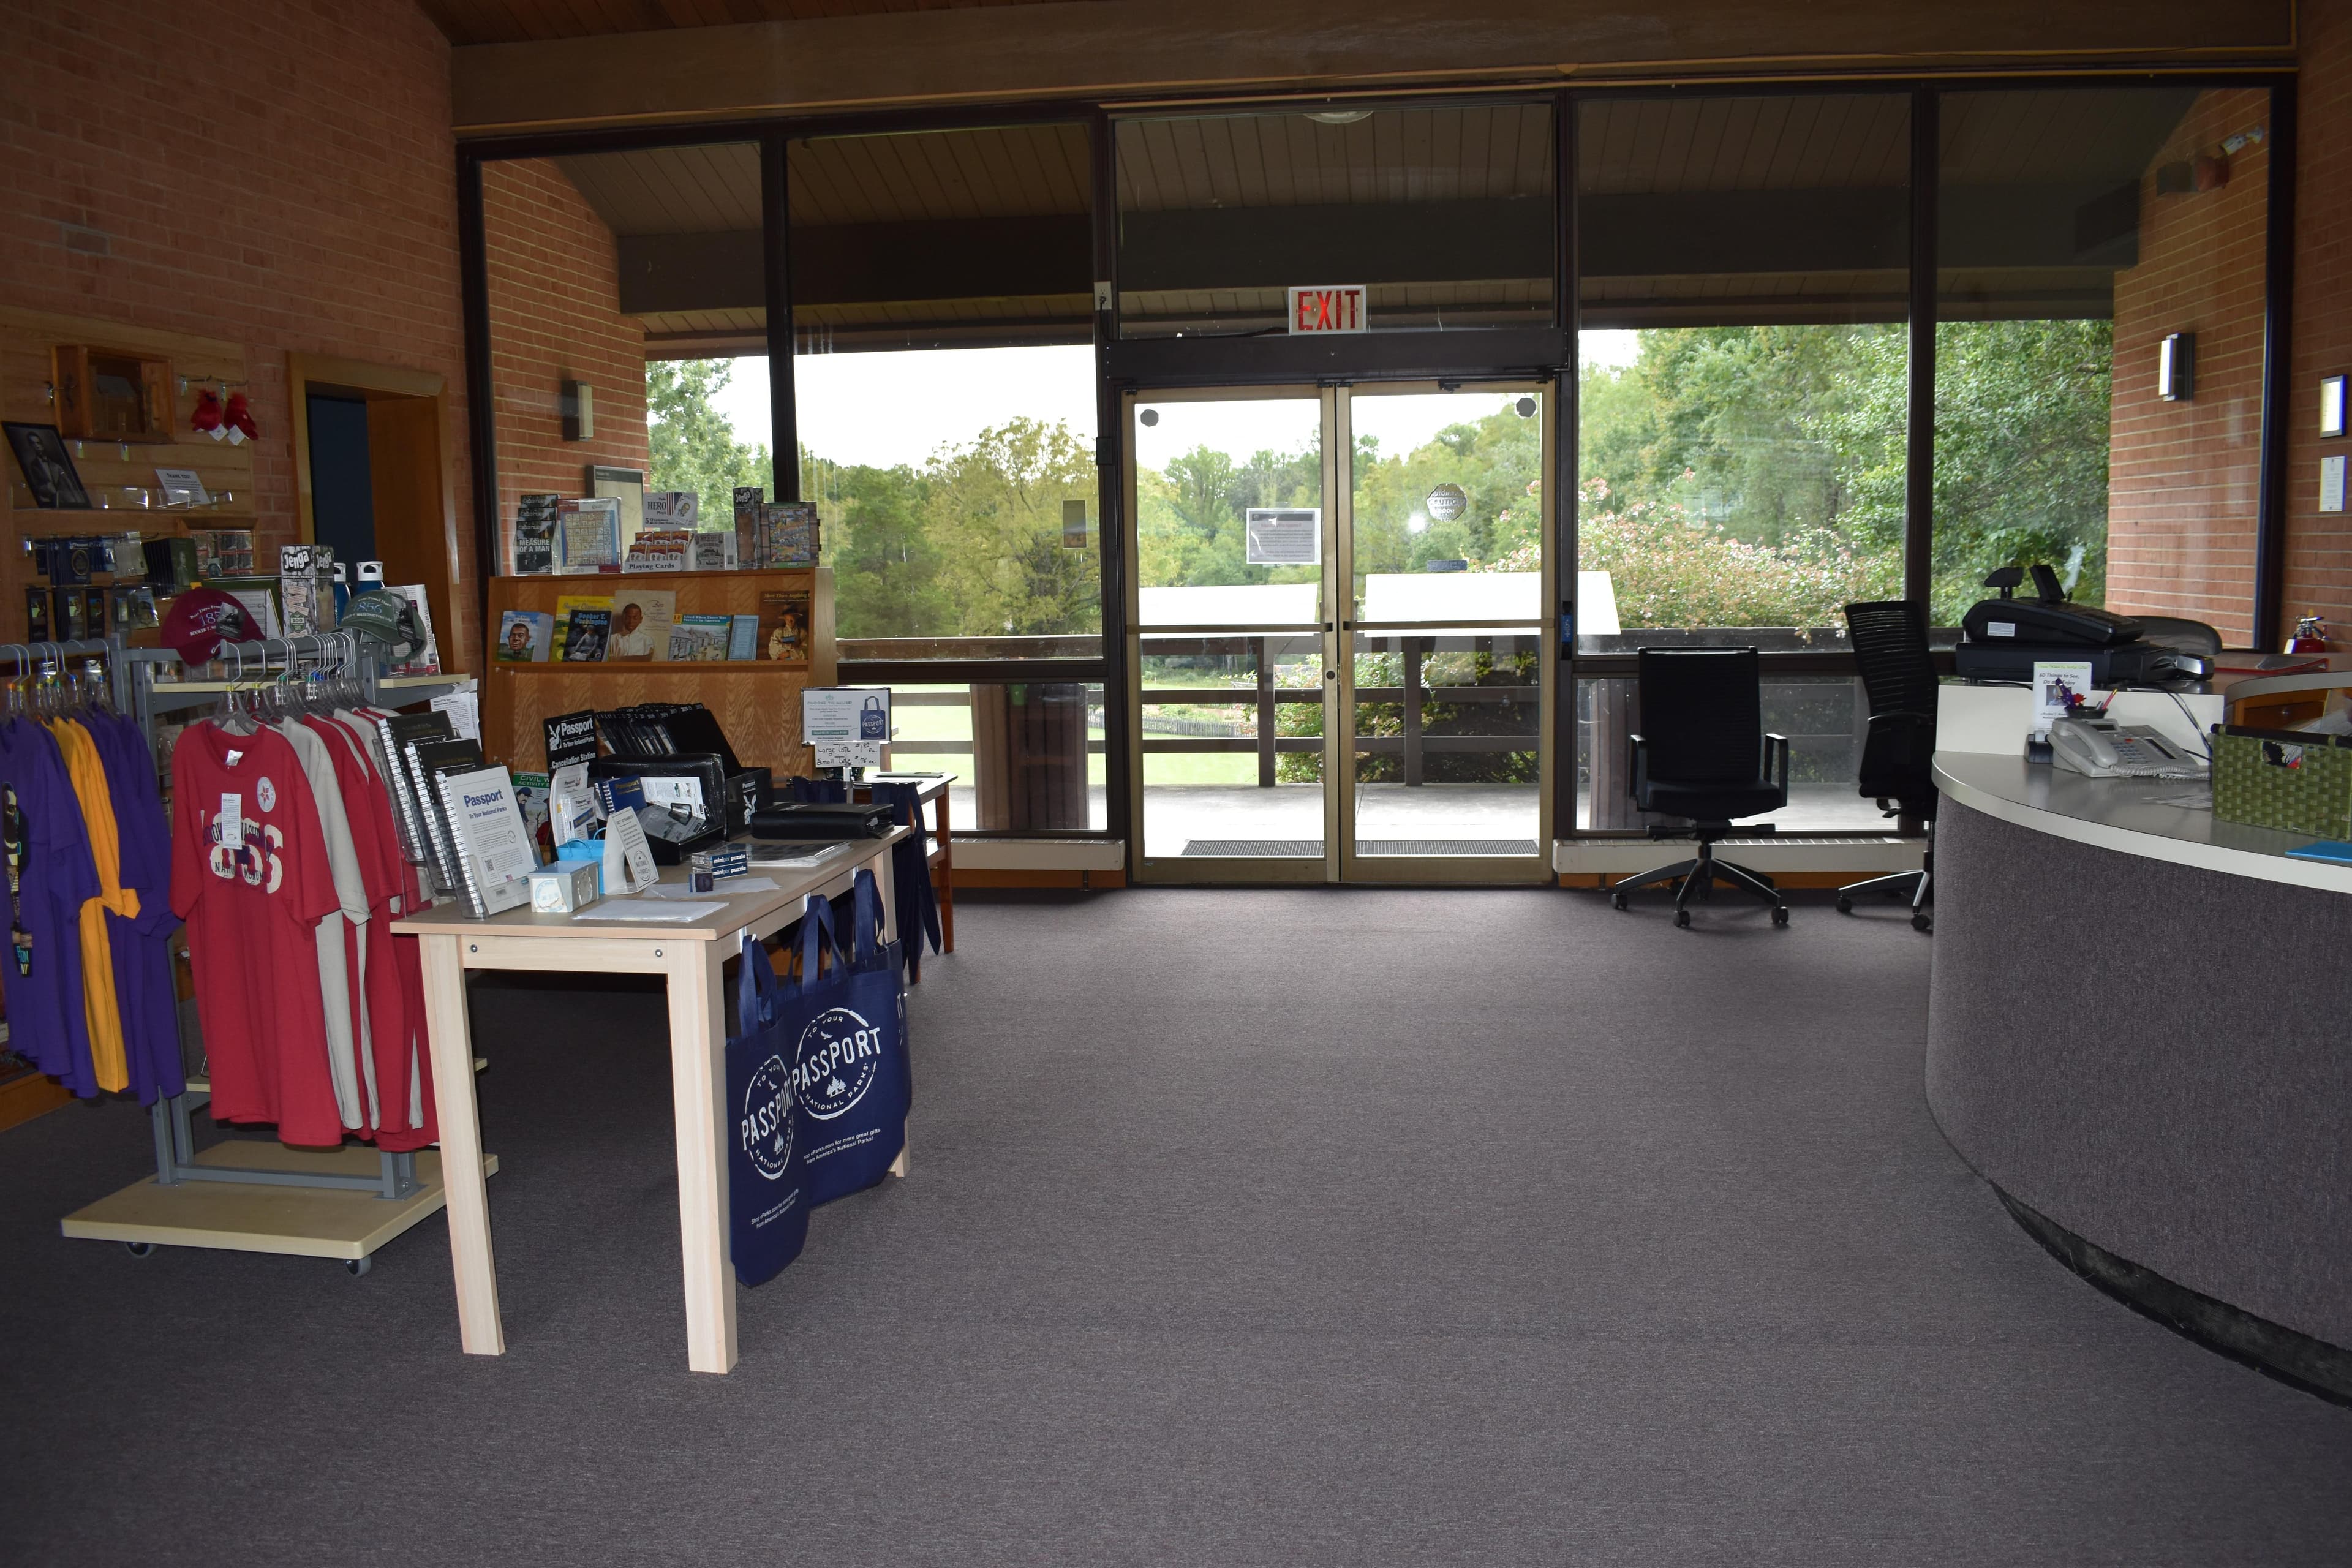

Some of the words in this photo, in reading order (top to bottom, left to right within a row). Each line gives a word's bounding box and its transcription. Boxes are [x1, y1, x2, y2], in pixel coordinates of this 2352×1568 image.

[1298, 290, 1360, 330] EXIT
[284, 550, 310, 570] Jenga
[315, 551, 333, 570] Jenga
[200, 611, 221, 627] 185
[561, 718, 594, 736] Passport
[862, 719, 884, 728] PASSPORT
[552, 755, 580, 769] Cancellation
[580, 752, 596, 761] Station
[817, 744, 835, 756] Large
[464, 788, 503, 808] Passport
[807, 1027, 817, 1038] TO
[822, 1016, 843, 1025] YOUR
[792, 1027, 881, 1096] PASSPORT
[757, 1074, 766, 1087] TO
[769, 1064, 781, 1073] YOU
[805, 1093, 844, 1110] NATIONAL
[848, 1065, 869, 1098] PARKS
[741, 1076, 794, 1152] PASSPORT
[810, 1142, 834, 1156] eParks.com
[856, 1131, 869, 1140] great
[870, 1128, 881, 1136] gifts
[816, 1148, 837, 1160] America's
[837, 1141, 857, 1152] National
[858, 1136, 873, 1145] Parks!
[755, 1148, 784, 1169] NATIONAL
